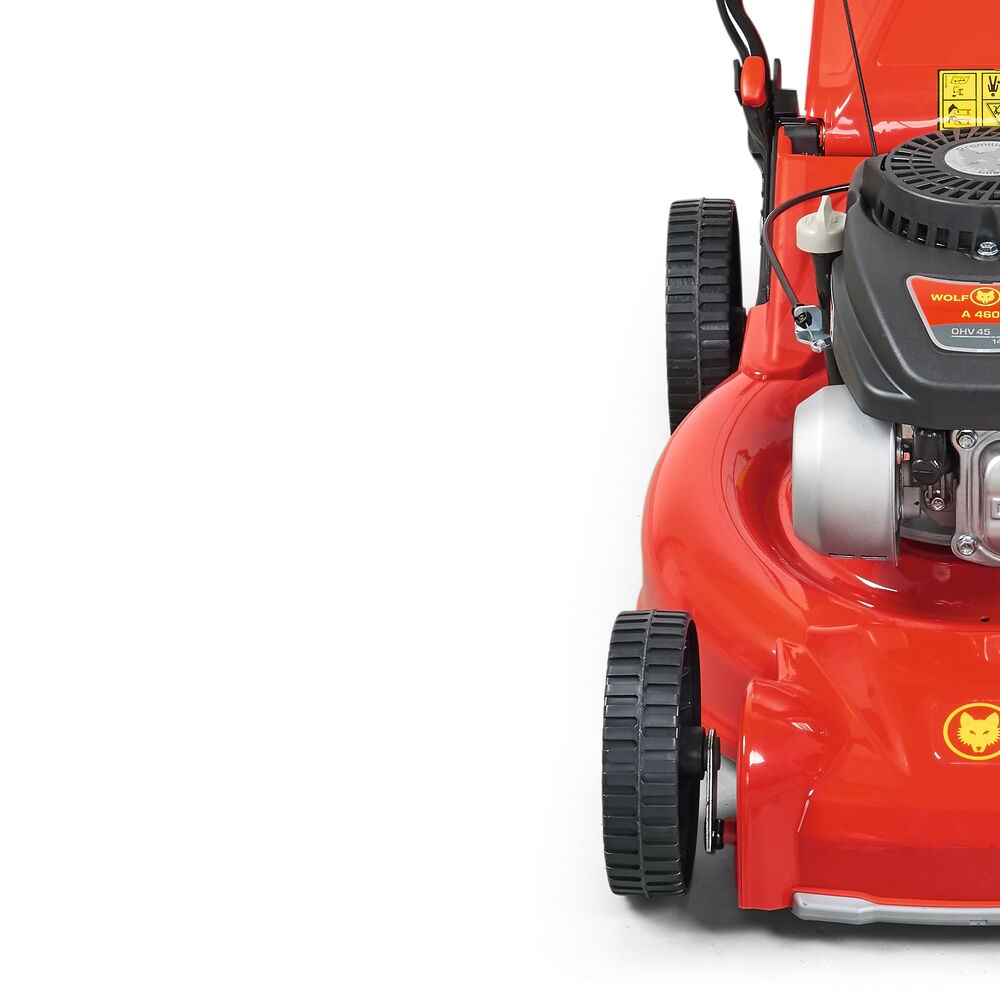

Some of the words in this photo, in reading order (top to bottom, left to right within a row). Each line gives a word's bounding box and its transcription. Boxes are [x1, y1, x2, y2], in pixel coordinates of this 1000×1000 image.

[931, 294, 969, 302] WOLF
[961, 310, 971, 319] A
[951, 327, 976, 336] OHV
[976, 328, 991, 336] 45
